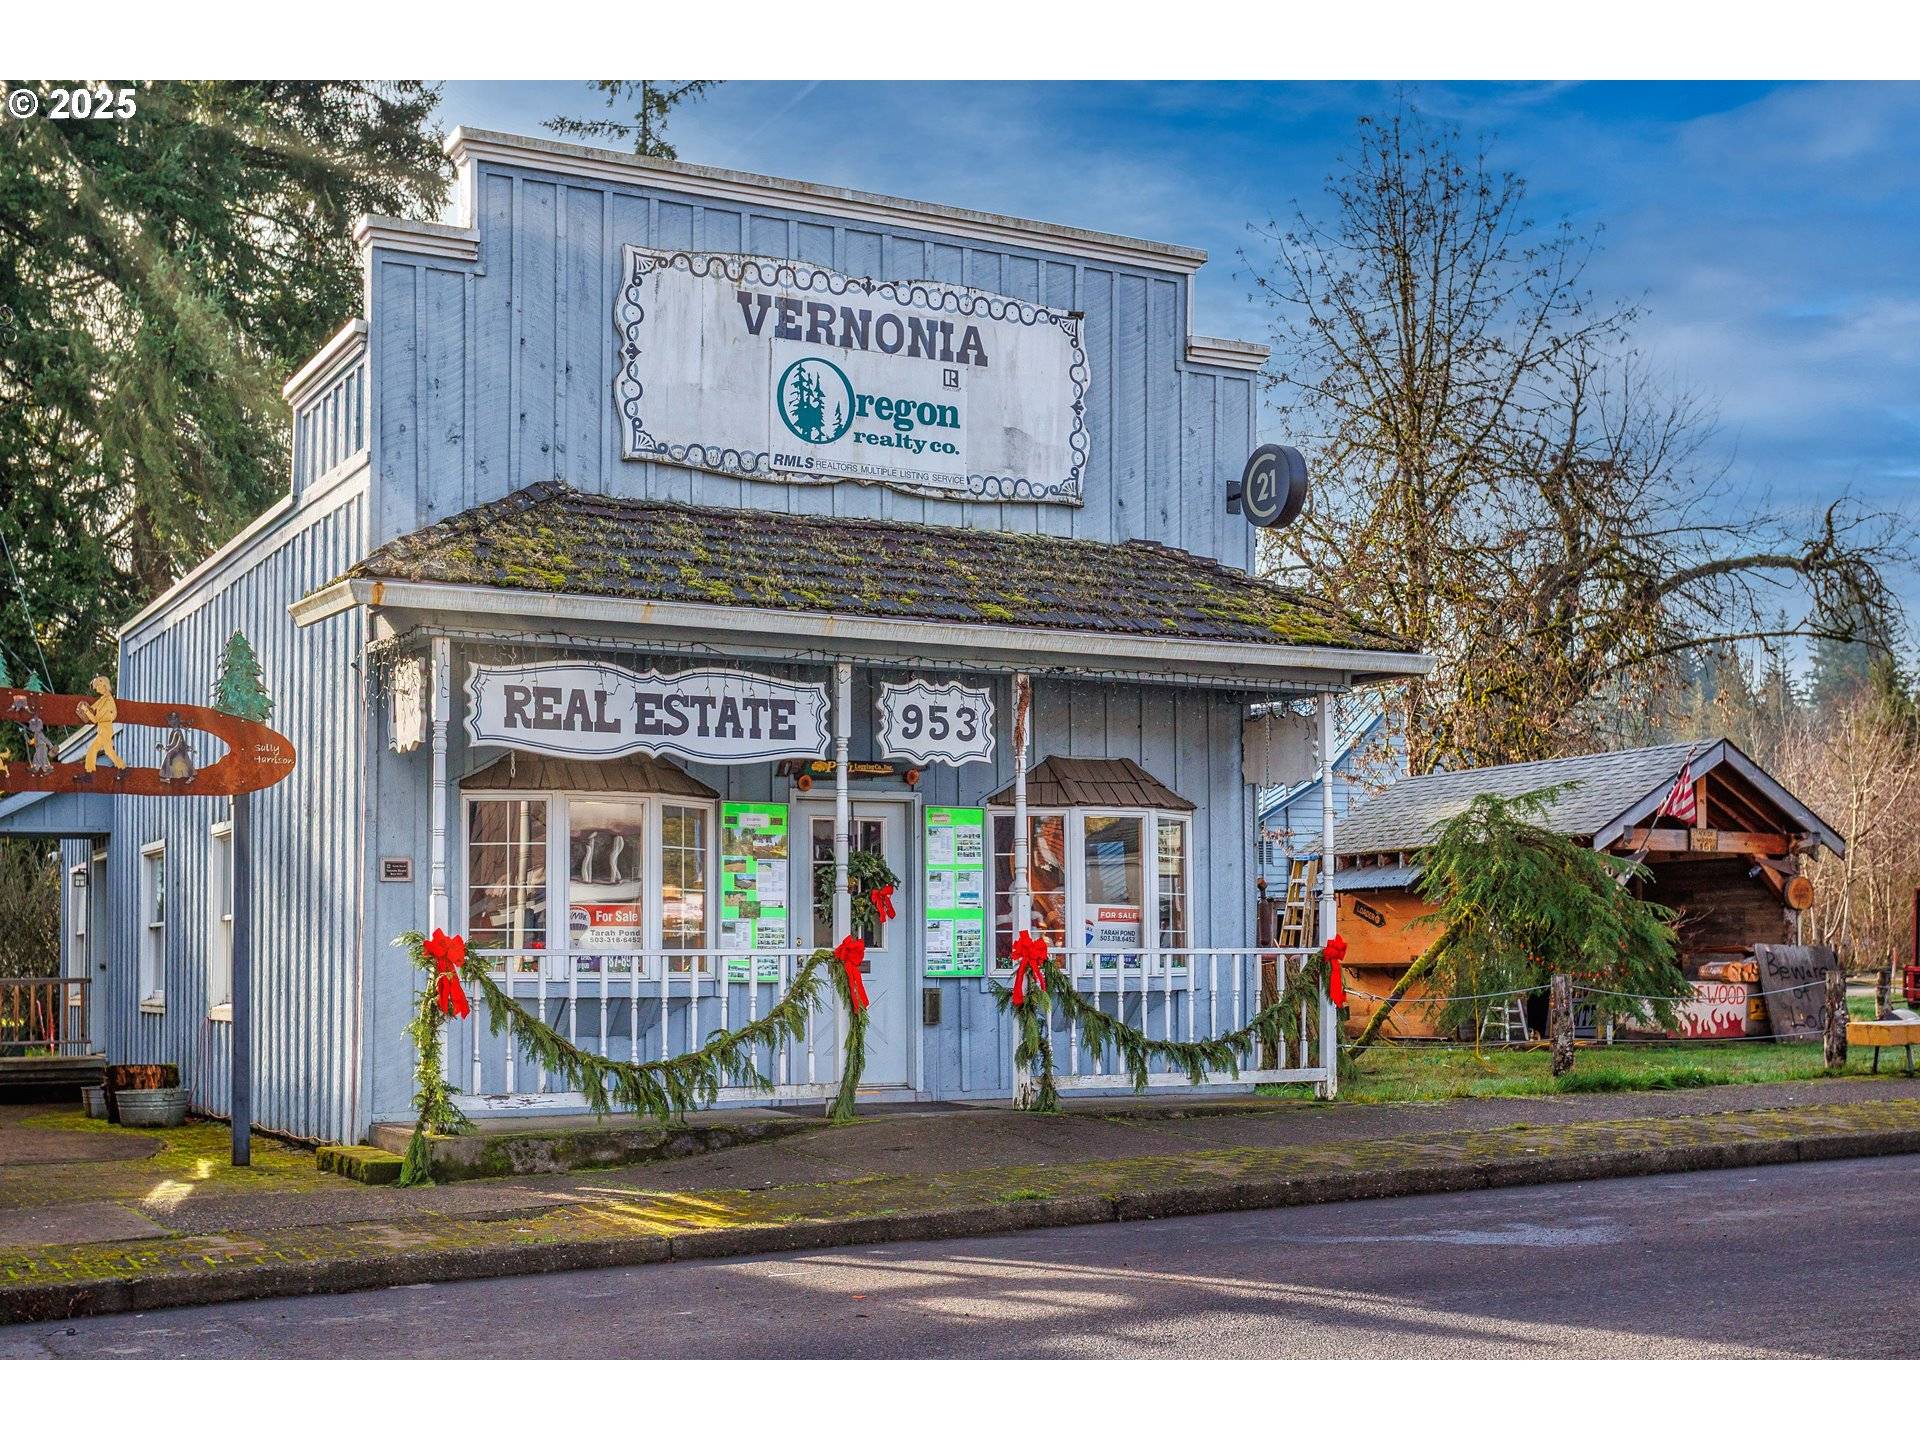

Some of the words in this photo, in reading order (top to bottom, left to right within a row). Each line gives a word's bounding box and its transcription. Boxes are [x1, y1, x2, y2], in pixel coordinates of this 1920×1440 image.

[736, 290, 989, 367] VERNONIA
[853, 431, 927, 455] realty
[929, 440, 960, 455] co.
[773, 453, 815, 469] RMLS
[815, 459, 858, 473] REALTORS
[860, 465, 897, 477] MULTIPLE
[900, 470, 929, 481] LISTING
[932, 473, 965, 485] SERVICE
[1256, 469, 1277, 502] 21
[503, 684, 622, 734] REAL
[634, 692, 797, 741] ESTATE
[901, 703, 978, 743] 953
[254, 754, 295, 765] Harrison
[255, 743, 280, 756] Sally
[595, 910, 614, 922] For
[615, 910, 639, 922] Sale
[1100, 911, 1117, 919] FOR
[590, 929, 616, 937] Tarah
[618, 929, 641, 937] Pond
